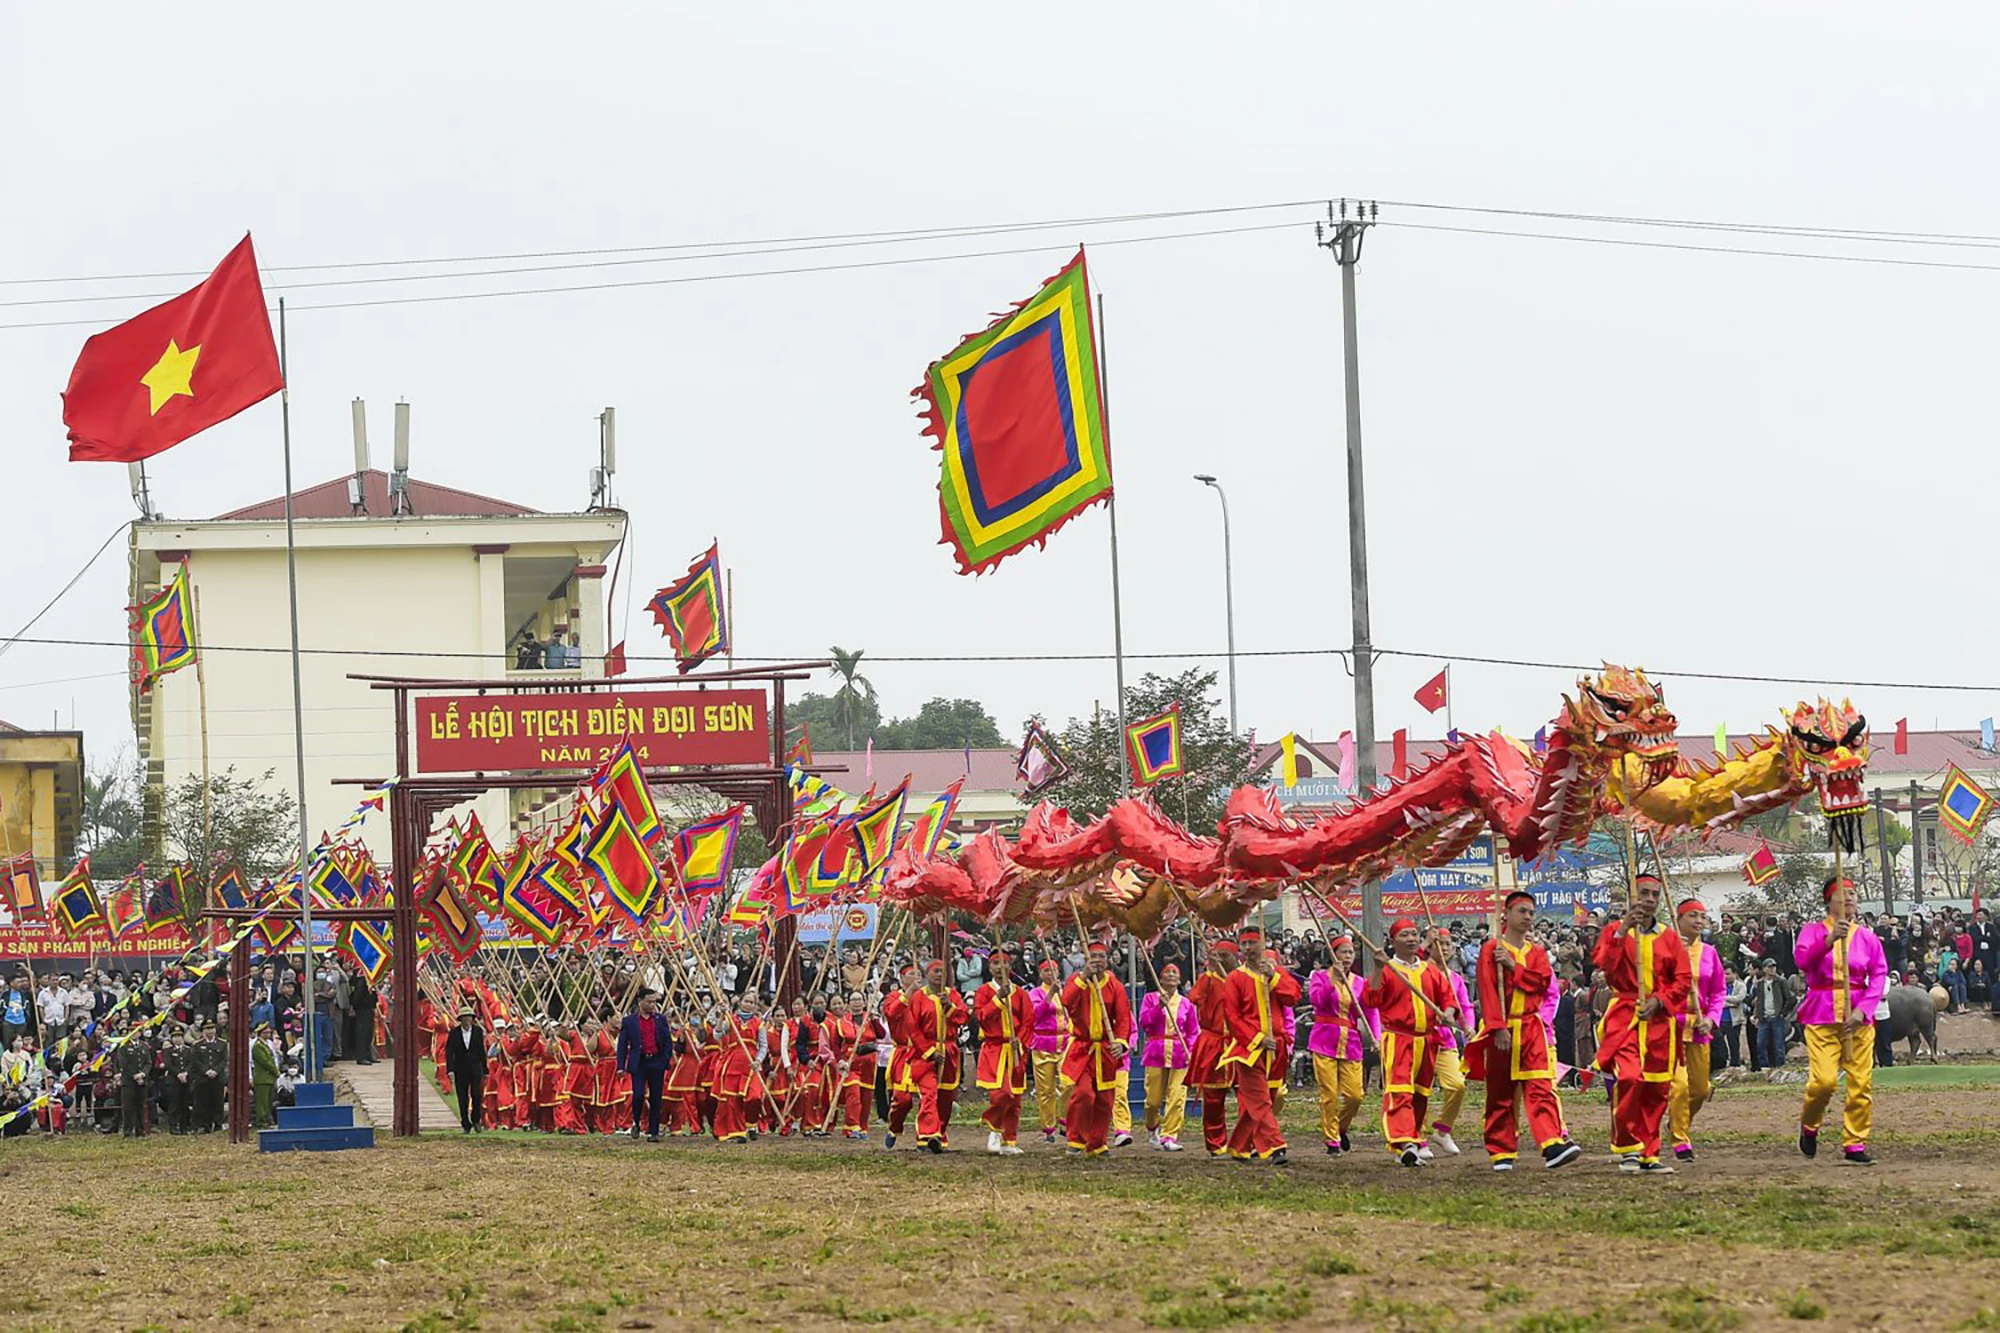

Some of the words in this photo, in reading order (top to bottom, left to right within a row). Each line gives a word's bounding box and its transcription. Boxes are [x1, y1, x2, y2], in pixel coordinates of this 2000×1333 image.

[430, 702, 461, 740] LỄ
[468, 705, 514, 744] HỘI
[521, 707, 579, 743] TỊCH
[587, 696, 645, 737] ĐIỀN
[652, 705, 696, 739] ĐỌI
[704, 700, 755, 732] SƠN
[540, 744, 592, 762] NĂM
[599, 746, 650, 761] 24
